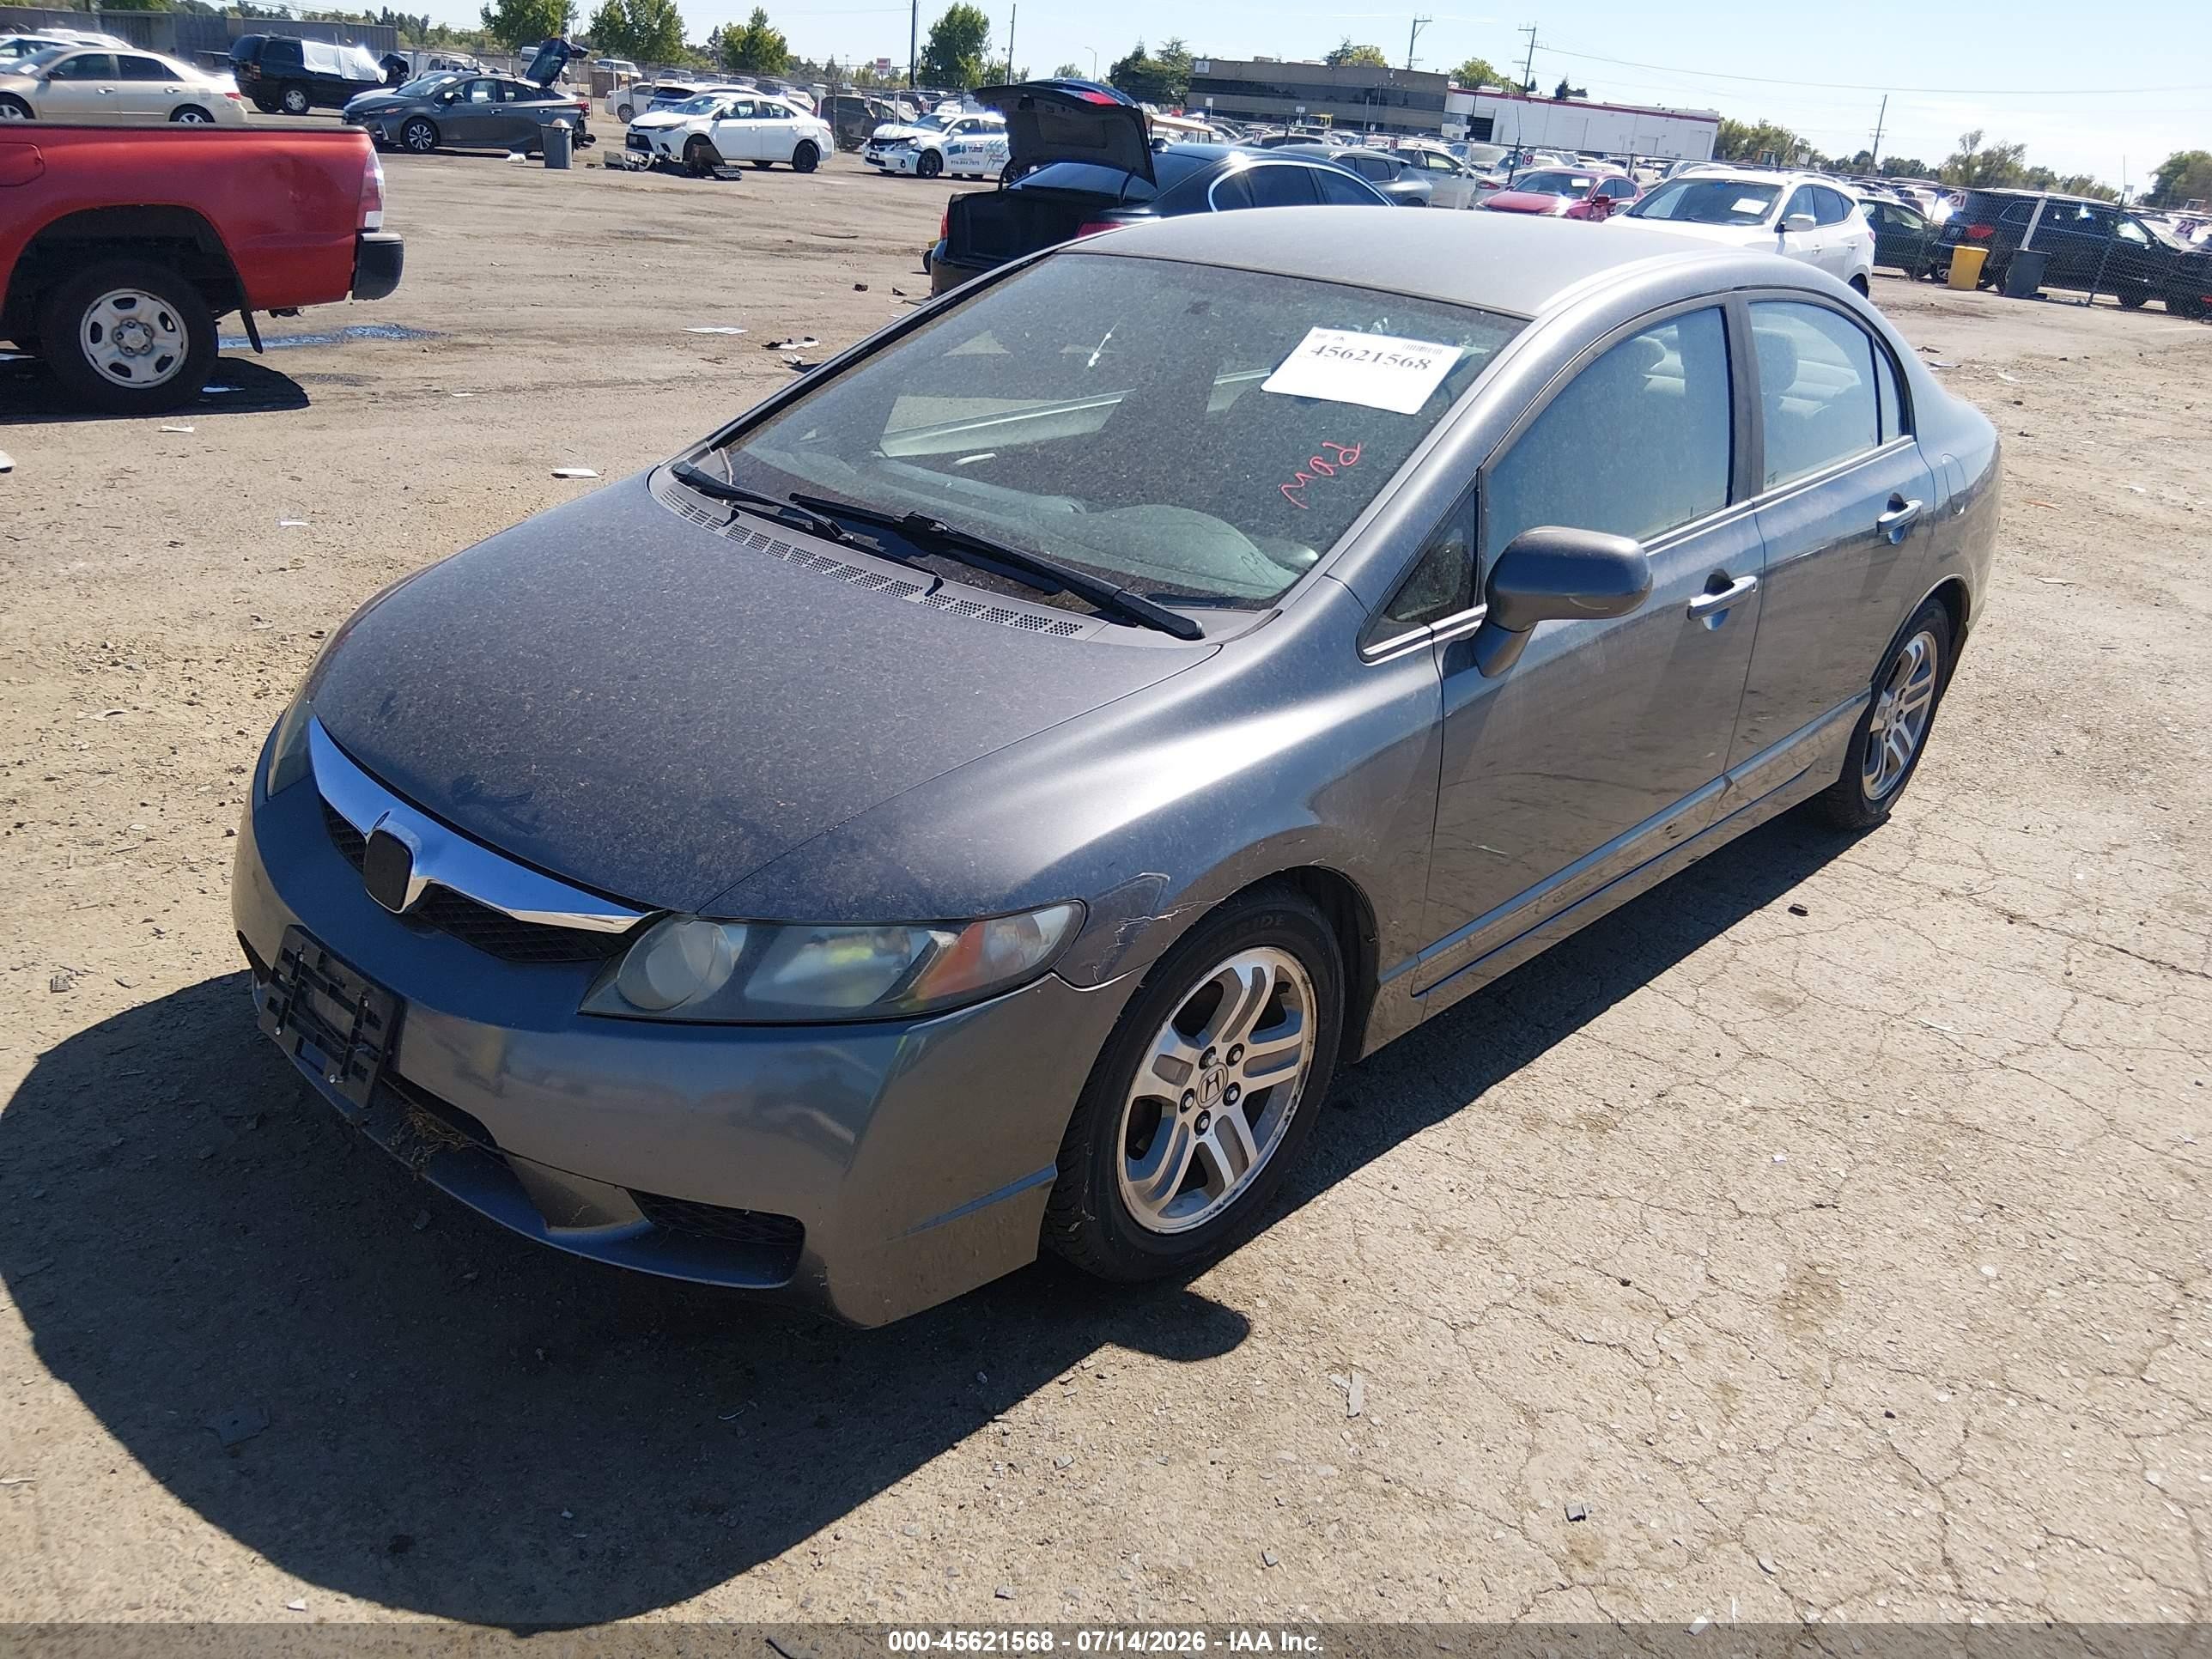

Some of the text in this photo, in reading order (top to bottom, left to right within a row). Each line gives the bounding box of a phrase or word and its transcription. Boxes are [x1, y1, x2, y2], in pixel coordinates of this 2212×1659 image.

[1253, 131, 1262, 142] 17
[1389, 139, 1399, 150] 18
[1521, 154, 1534, 166] 19
[1948, 194, 1966, 207] 21
[2175, 220, 2197, 235] 22
[1310, 343, 1432, 371] 45621568
